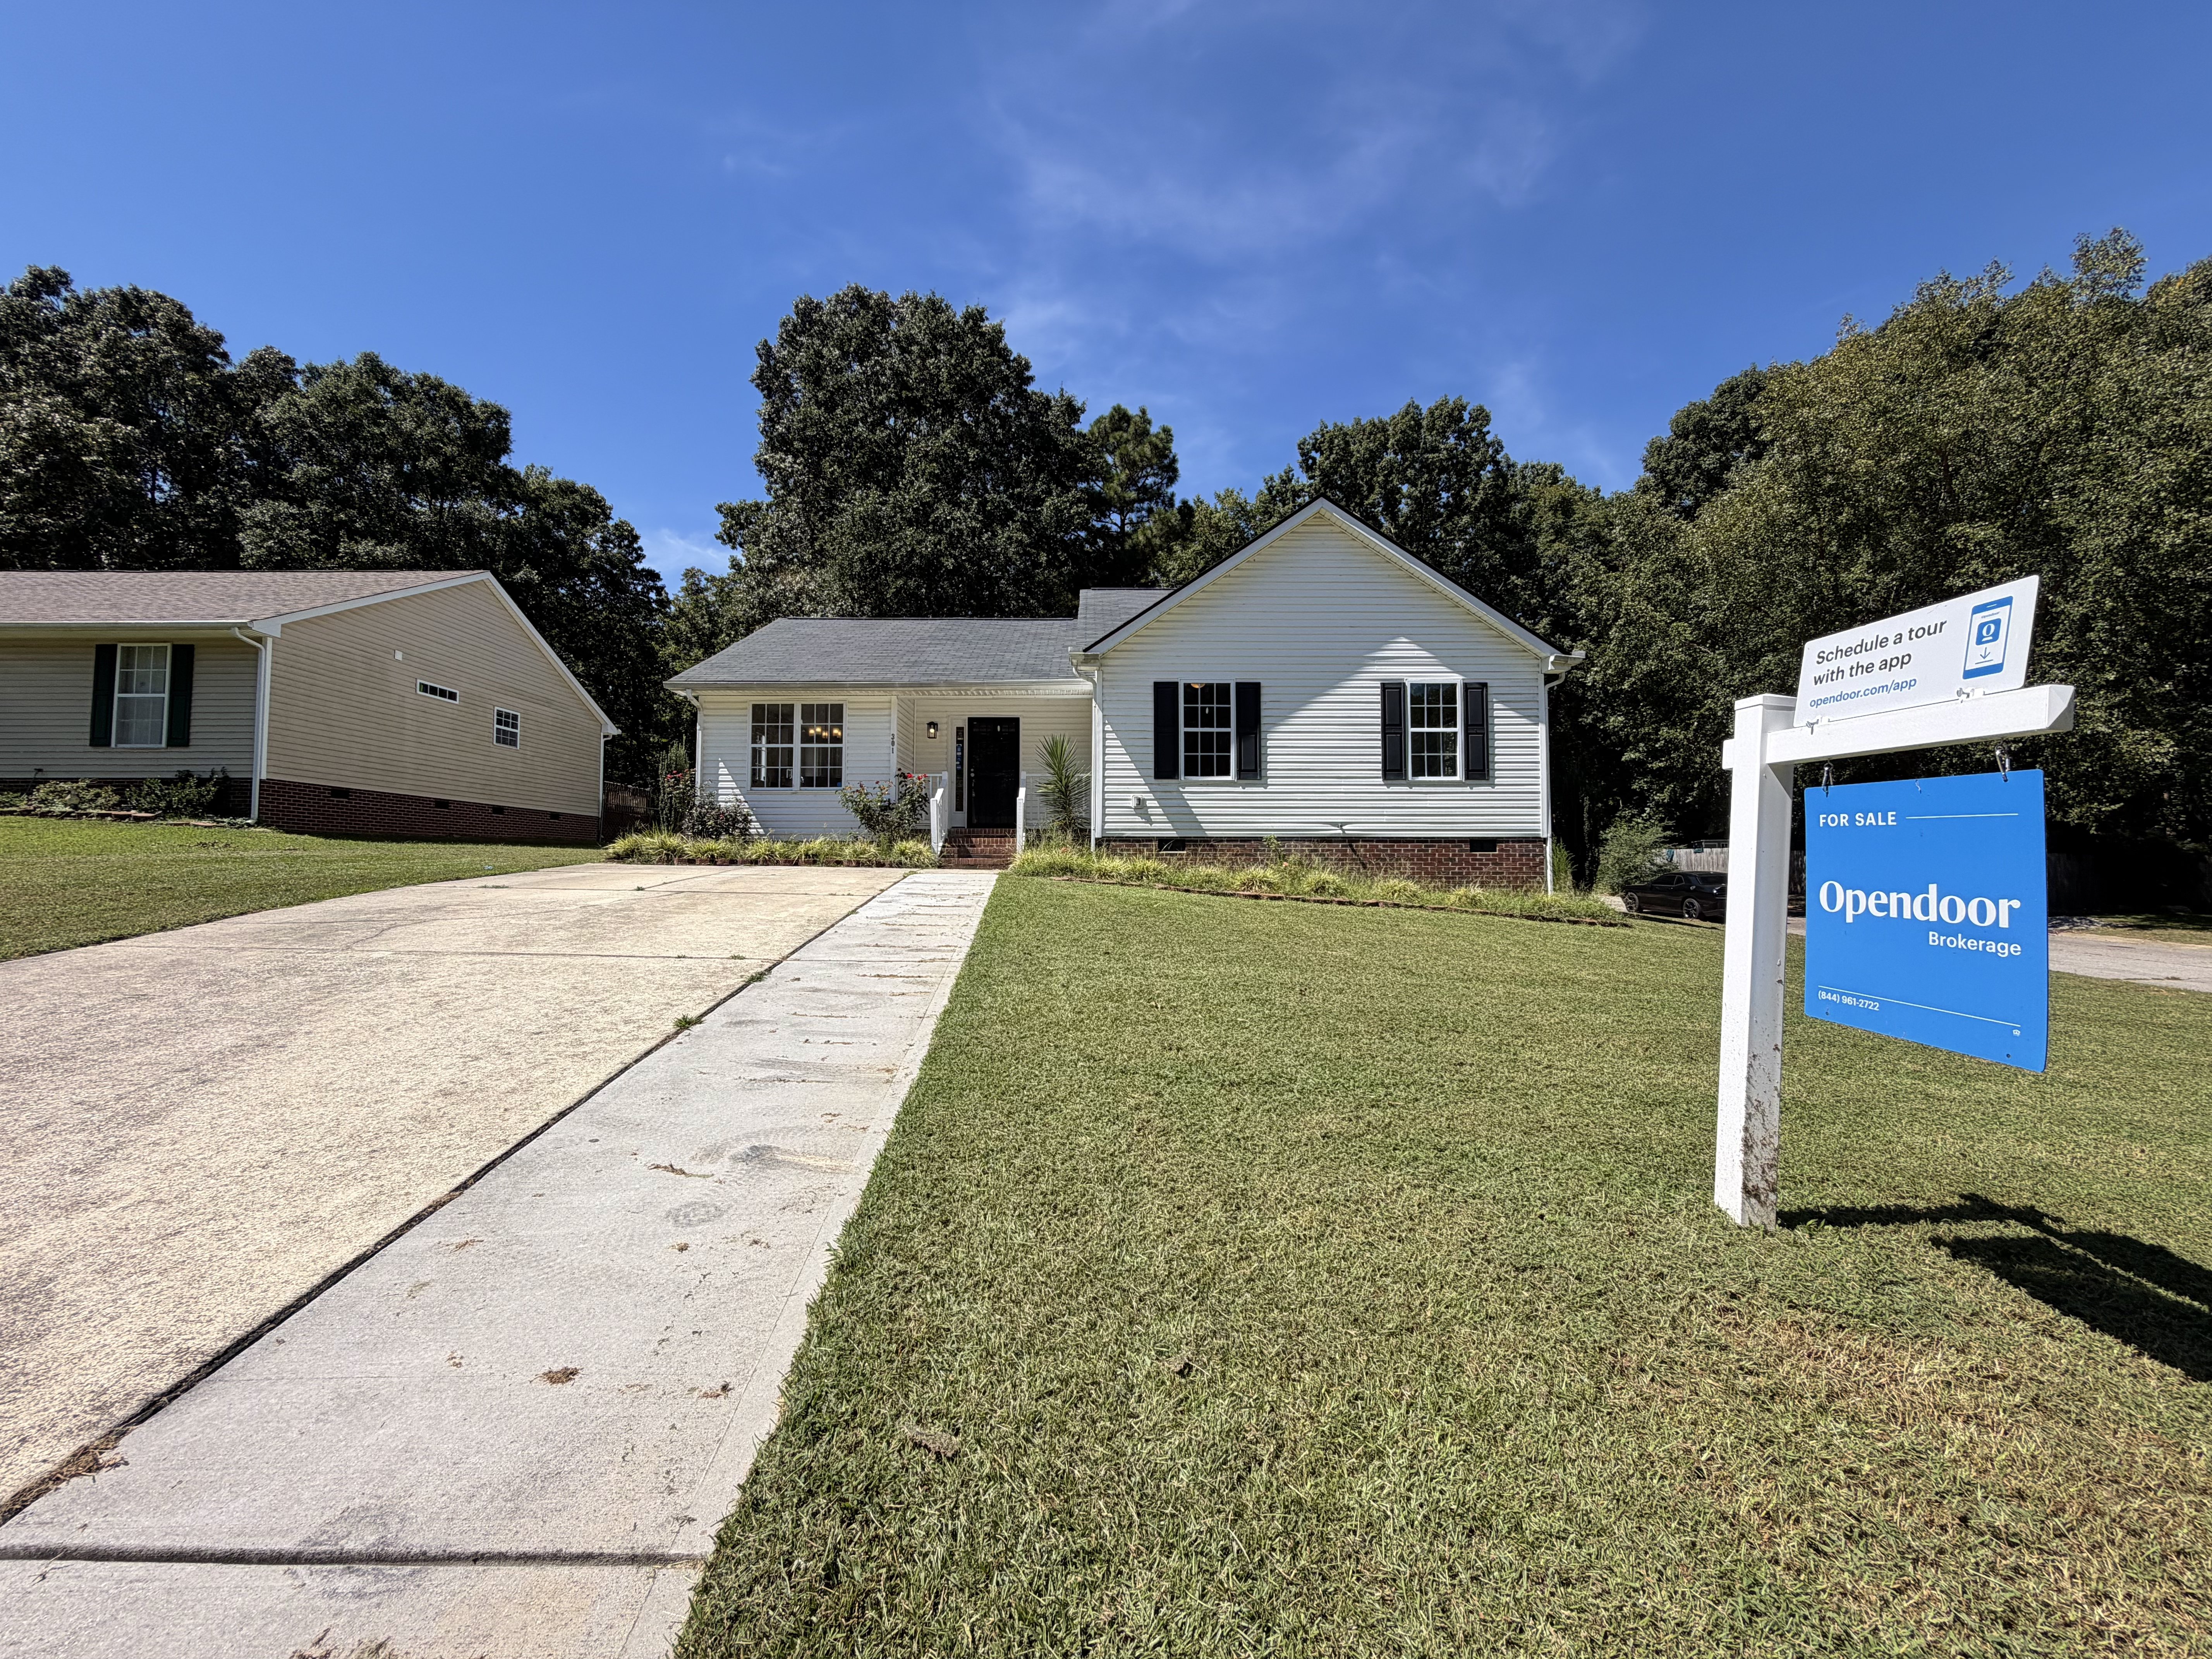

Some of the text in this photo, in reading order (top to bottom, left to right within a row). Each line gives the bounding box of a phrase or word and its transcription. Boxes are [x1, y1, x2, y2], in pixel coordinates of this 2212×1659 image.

[1816, 620, 1947, 665] Schedule a tour
[1814, 653, 1911, 685] with the app
[1810, 678, 1917, 708] opendoor.com/app
[1820, 811, 1897, 827] FOR SALE
[1819, 881, 2021, 928] Opendoor
[1929, 931, 2021, 957] Brokerage
[1818, 990, 1880, 1011] (844) 961-2722
